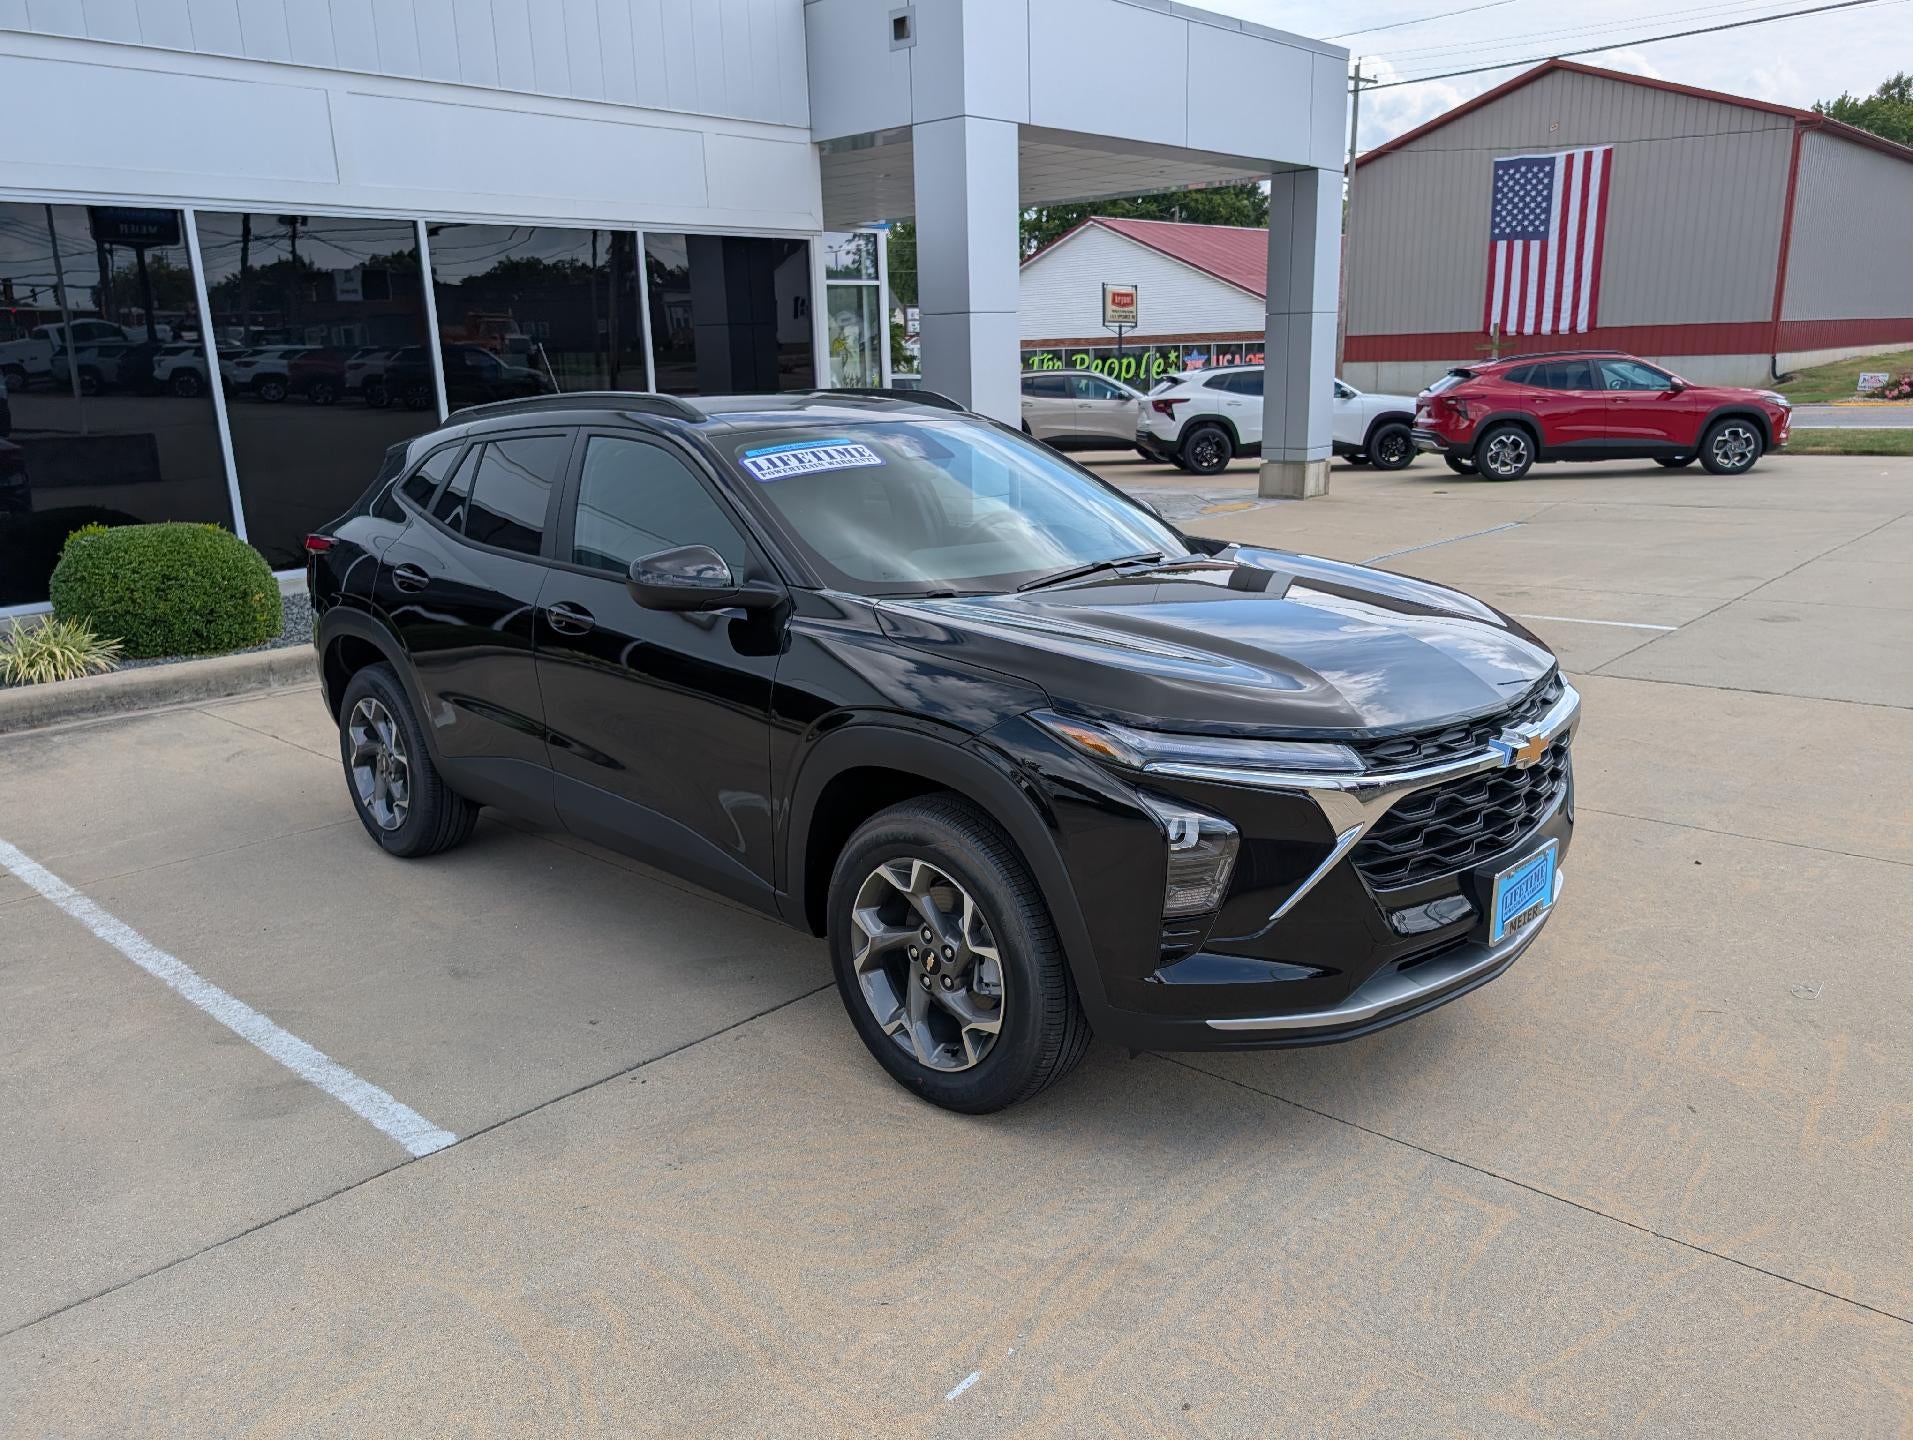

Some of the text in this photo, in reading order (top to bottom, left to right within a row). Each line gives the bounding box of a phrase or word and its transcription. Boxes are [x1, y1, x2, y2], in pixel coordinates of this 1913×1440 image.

[748, 446, 872, 473] LIFETIME
[759, 457, 878, 478] POWERTRAIN WARRANTY
[1503, 862, 1546, 911] LIFETIME
[1509, 903, 1539, 935] MEIER
